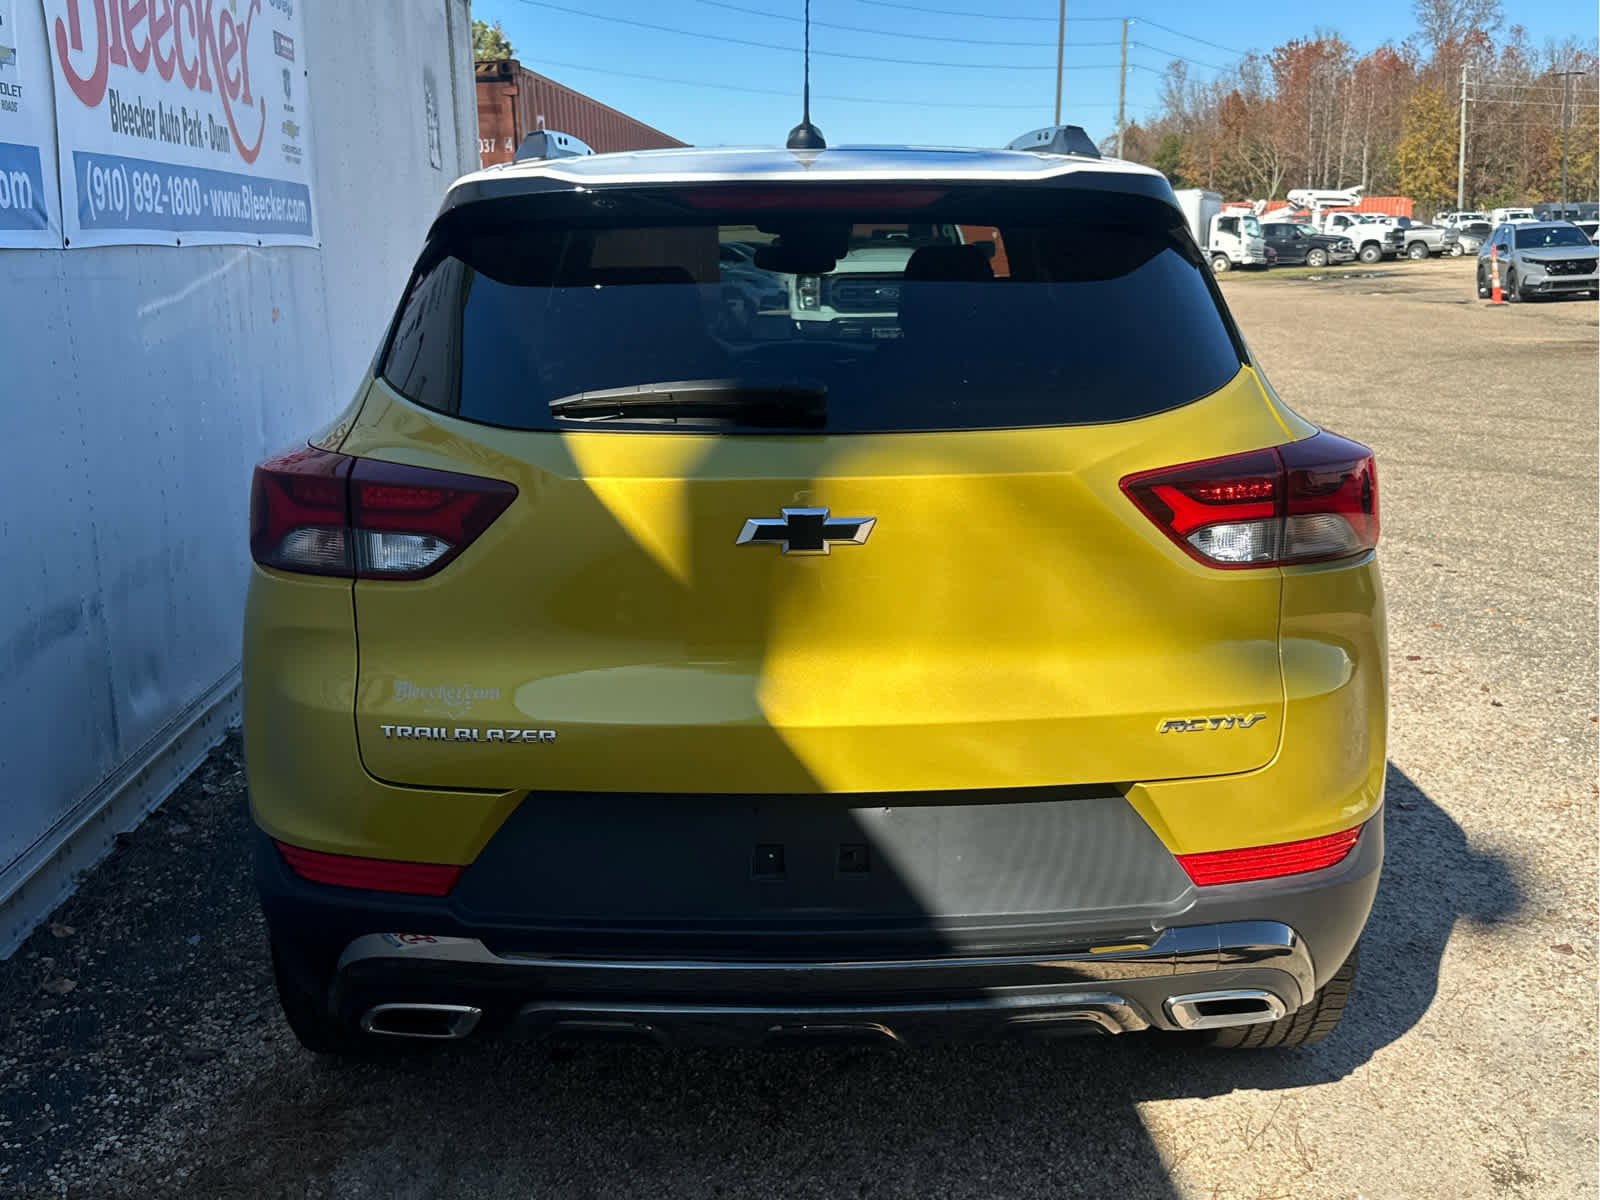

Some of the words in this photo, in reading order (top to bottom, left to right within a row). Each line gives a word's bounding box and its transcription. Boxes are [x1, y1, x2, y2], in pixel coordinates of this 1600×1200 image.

[108, 88, 157, 140] Bleecker
[158, 100, 181, 145] Auto
[181, 106, 204, 148] Park
[208, 113, 231, 152] Dunn
[87, 160, 130, 221] (910)
[132, 170, 201, 216] 892-1800
[209, 185, 308, 225] www.Bleecker.com
[380, 725, 557, 744] TRAILBLAZER
[1159, 713, 1267, 734] ACTIV
